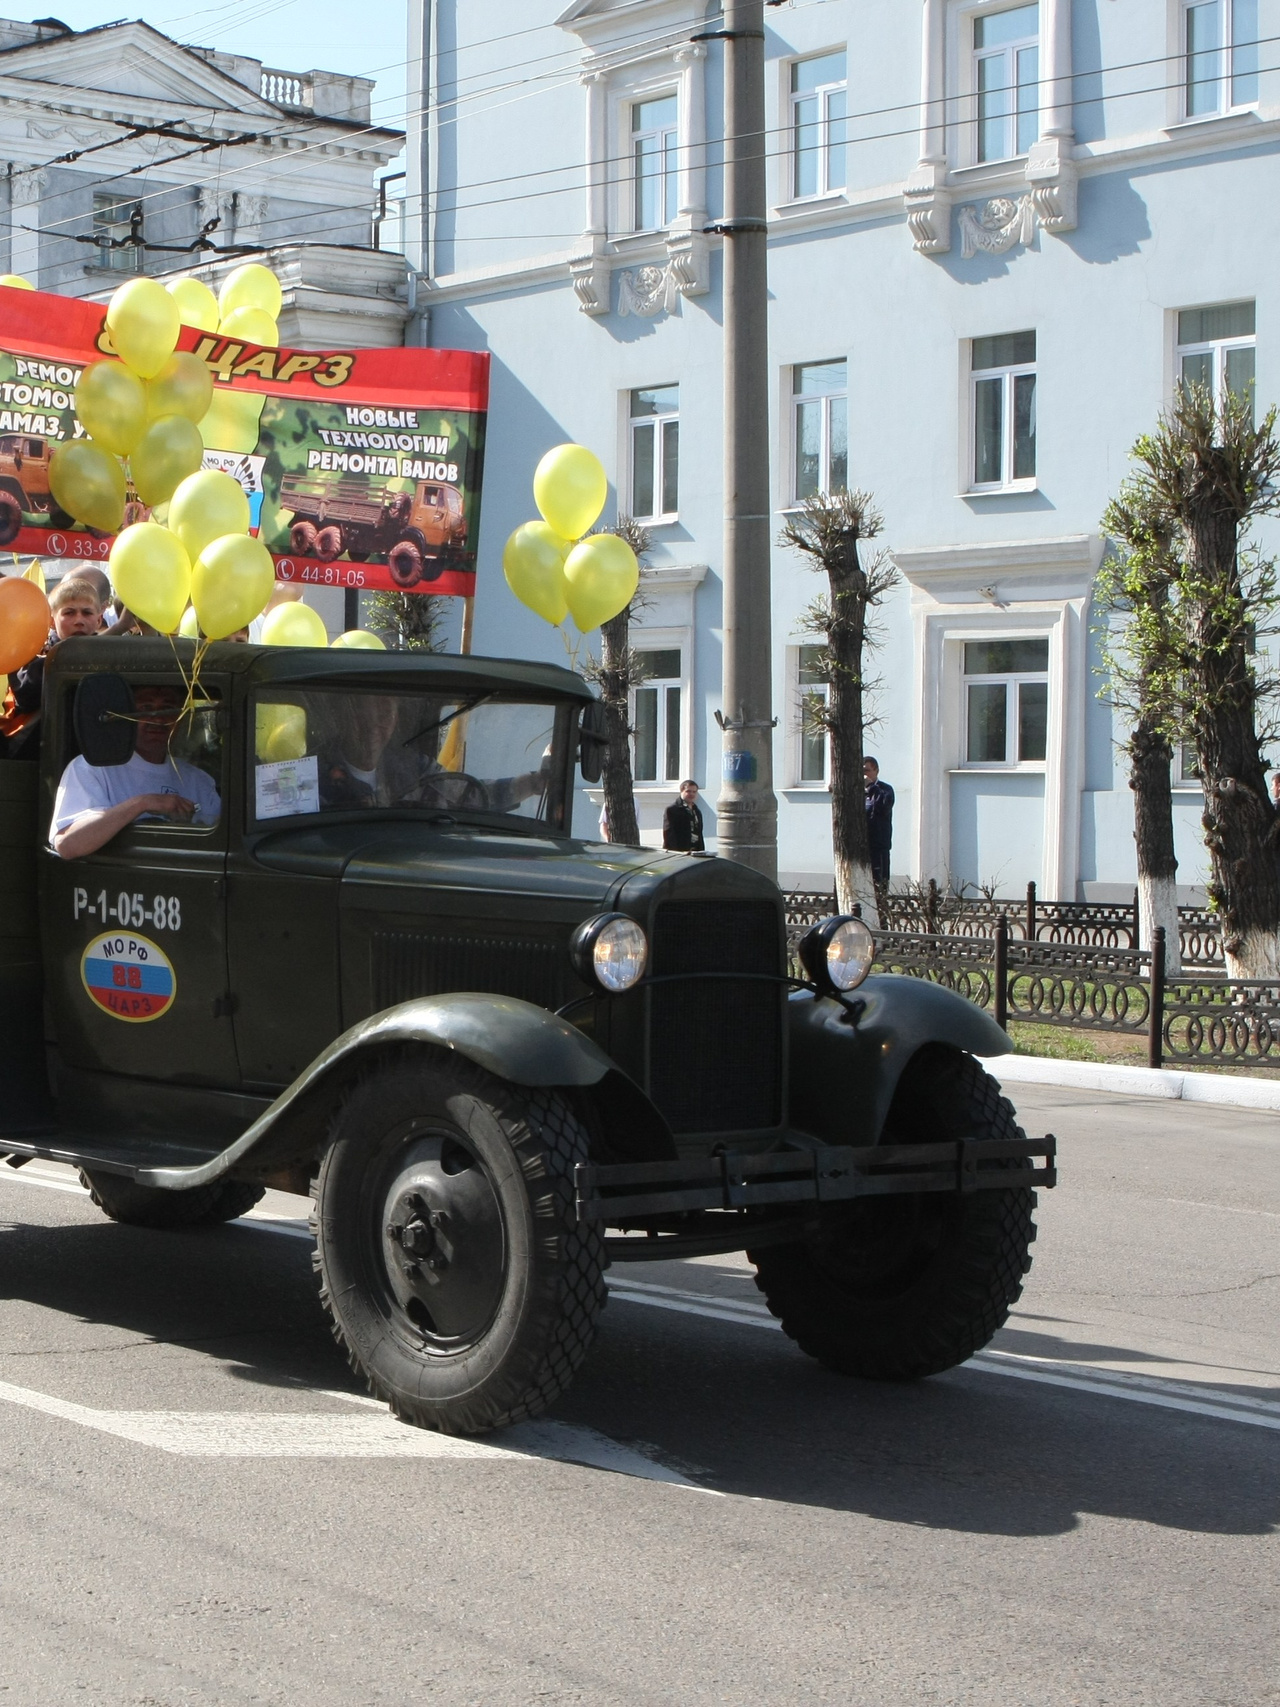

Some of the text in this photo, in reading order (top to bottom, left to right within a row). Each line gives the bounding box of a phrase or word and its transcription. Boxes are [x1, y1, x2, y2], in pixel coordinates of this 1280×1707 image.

[197, 337, 354, 387] ЦАРЗ
[345, 407, 419, 428] НОВЫЕ
[318, 429, 449, 455] ТЕХНОЛОГИИ
[206, 457, 236, 467] МО РФ
[307, 450, 459, 482] РЕМОНТА ВАЛОВ
[301, 565, 366, 587] 44-81-05
[73, 886, 182, 931] Р-1-05-88
[102, 938, 149, 961] МО РФ
[111, 963, 143, 989] 88
[107, 992, 153, 1015] ЦАРЗ
